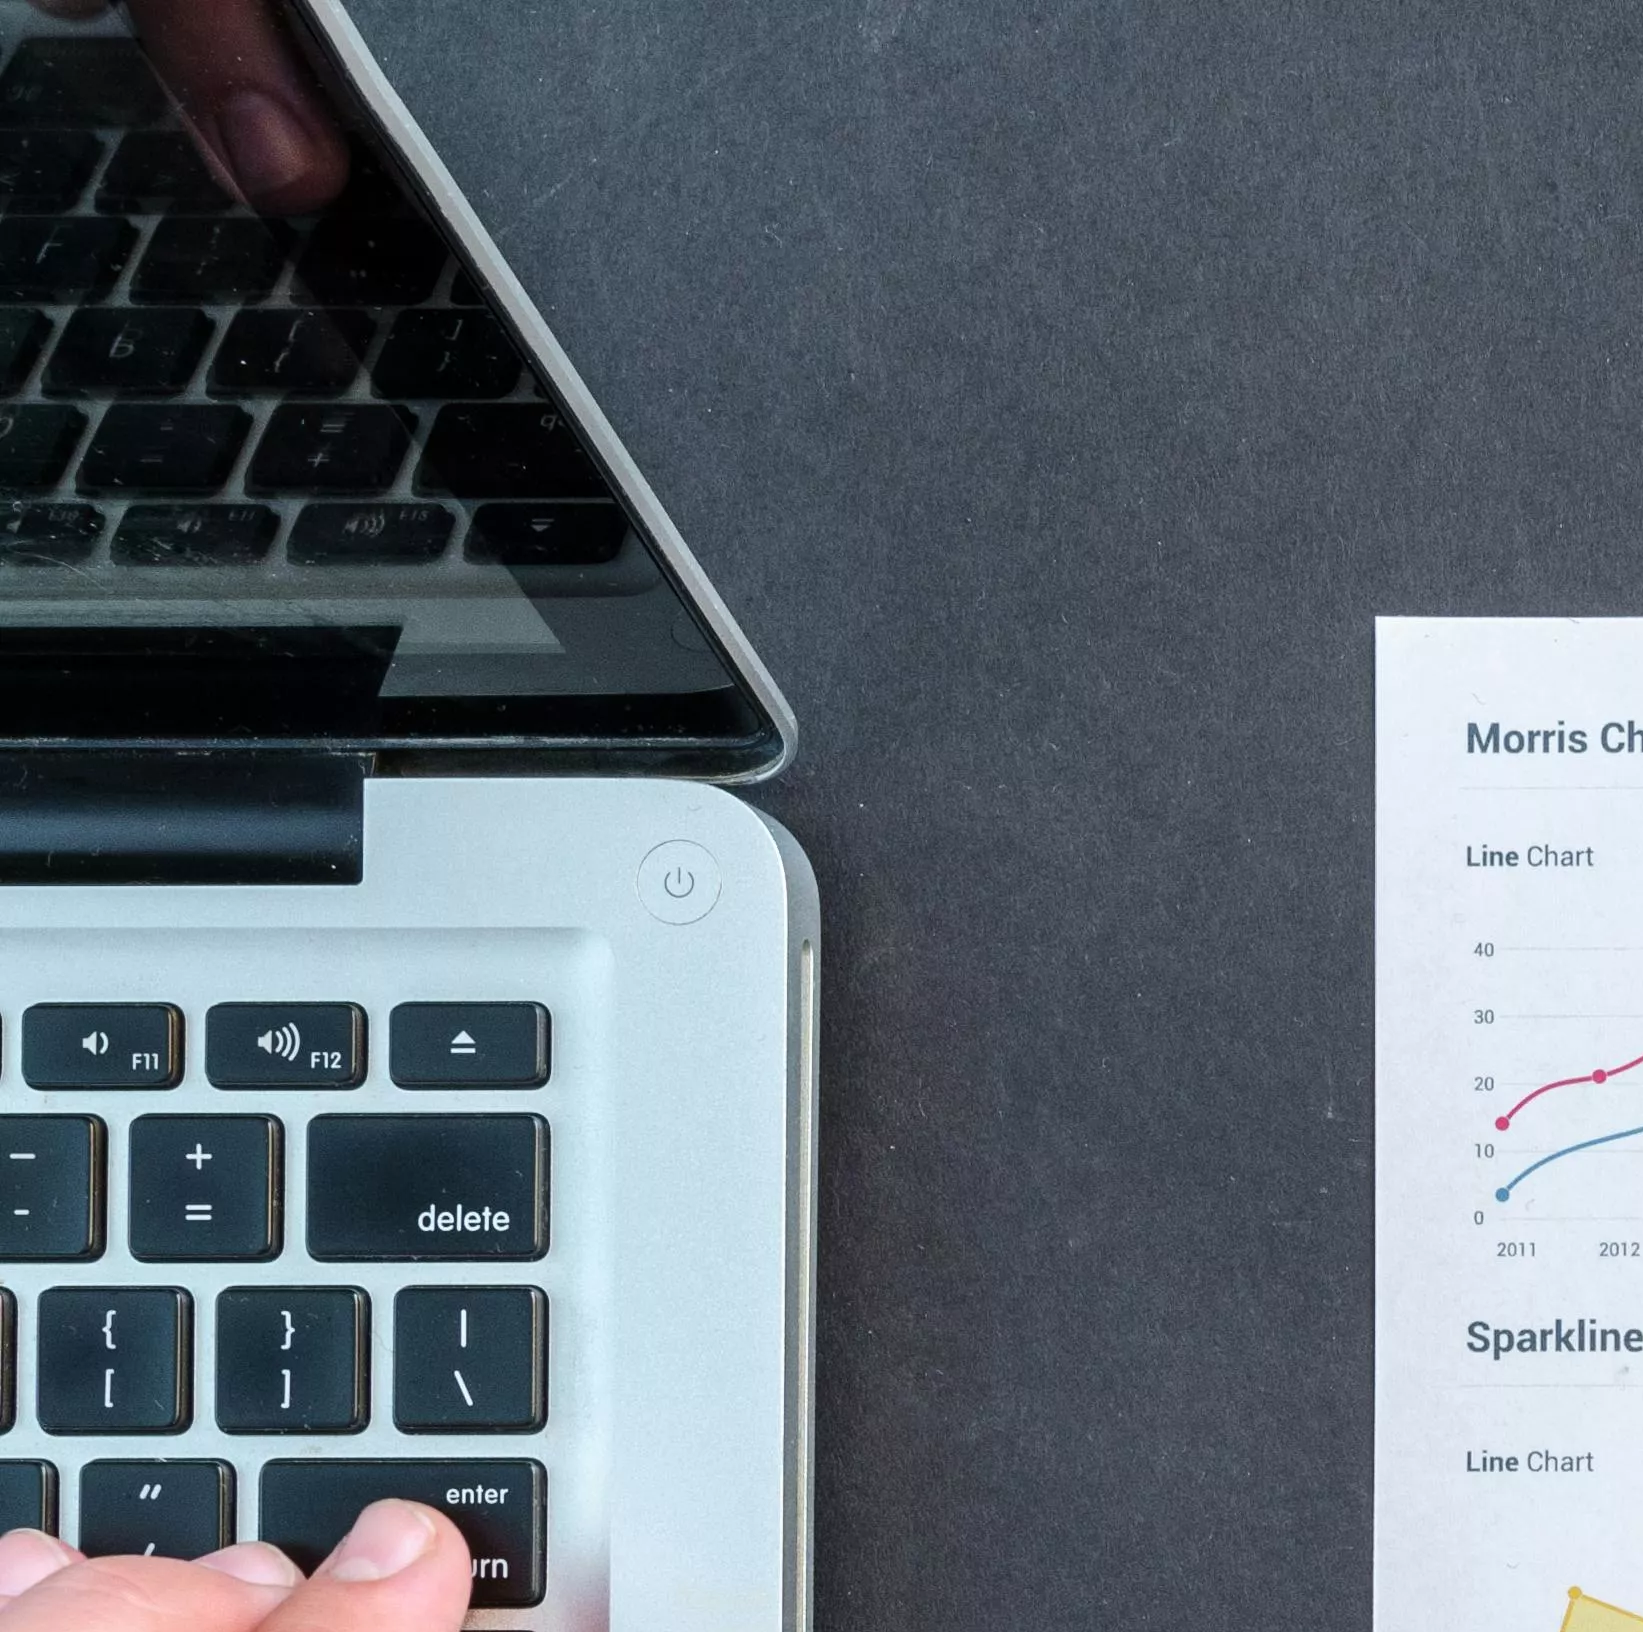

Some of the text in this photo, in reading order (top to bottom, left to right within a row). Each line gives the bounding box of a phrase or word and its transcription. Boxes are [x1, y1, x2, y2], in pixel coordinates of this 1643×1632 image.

[1467, 720, 1588, 754] Morris
[1466, 843, 1594, 868] Line Chart
[1473, 942, 1495, 958] 40
[1474, 1009, 1495, 1025] 30
[132, 1052, 159, 1071] F11
[310, 1051, 342, 1069] F12
[1474, 1076, 1495, 1092] 20
[185, 1143, 213, 1170] +
[1474, 1143, 1495, 1159] 10
[185, 1204, 213, 1221] =
[417, 1203, 510, 1232] delete
[1473, 1210, 1484, 1226] 0
[1496, 1242, 1536, 1257] 2011
[1599, 1241, 1641, 1257] 2012
[101, 1309, 117, 1350] {
[280, 1310, 296, 1350] }
[1466, 1318, 1643, 1361] Sparkline
[104, 1368, 115, 1408] [
[280, 1368, 291, 1409] ]
[453, 1370, 474, 1407] \
[1466, 1449, 1594, 1473] Line Chart
[446, 1484, 509, 1505] enter
